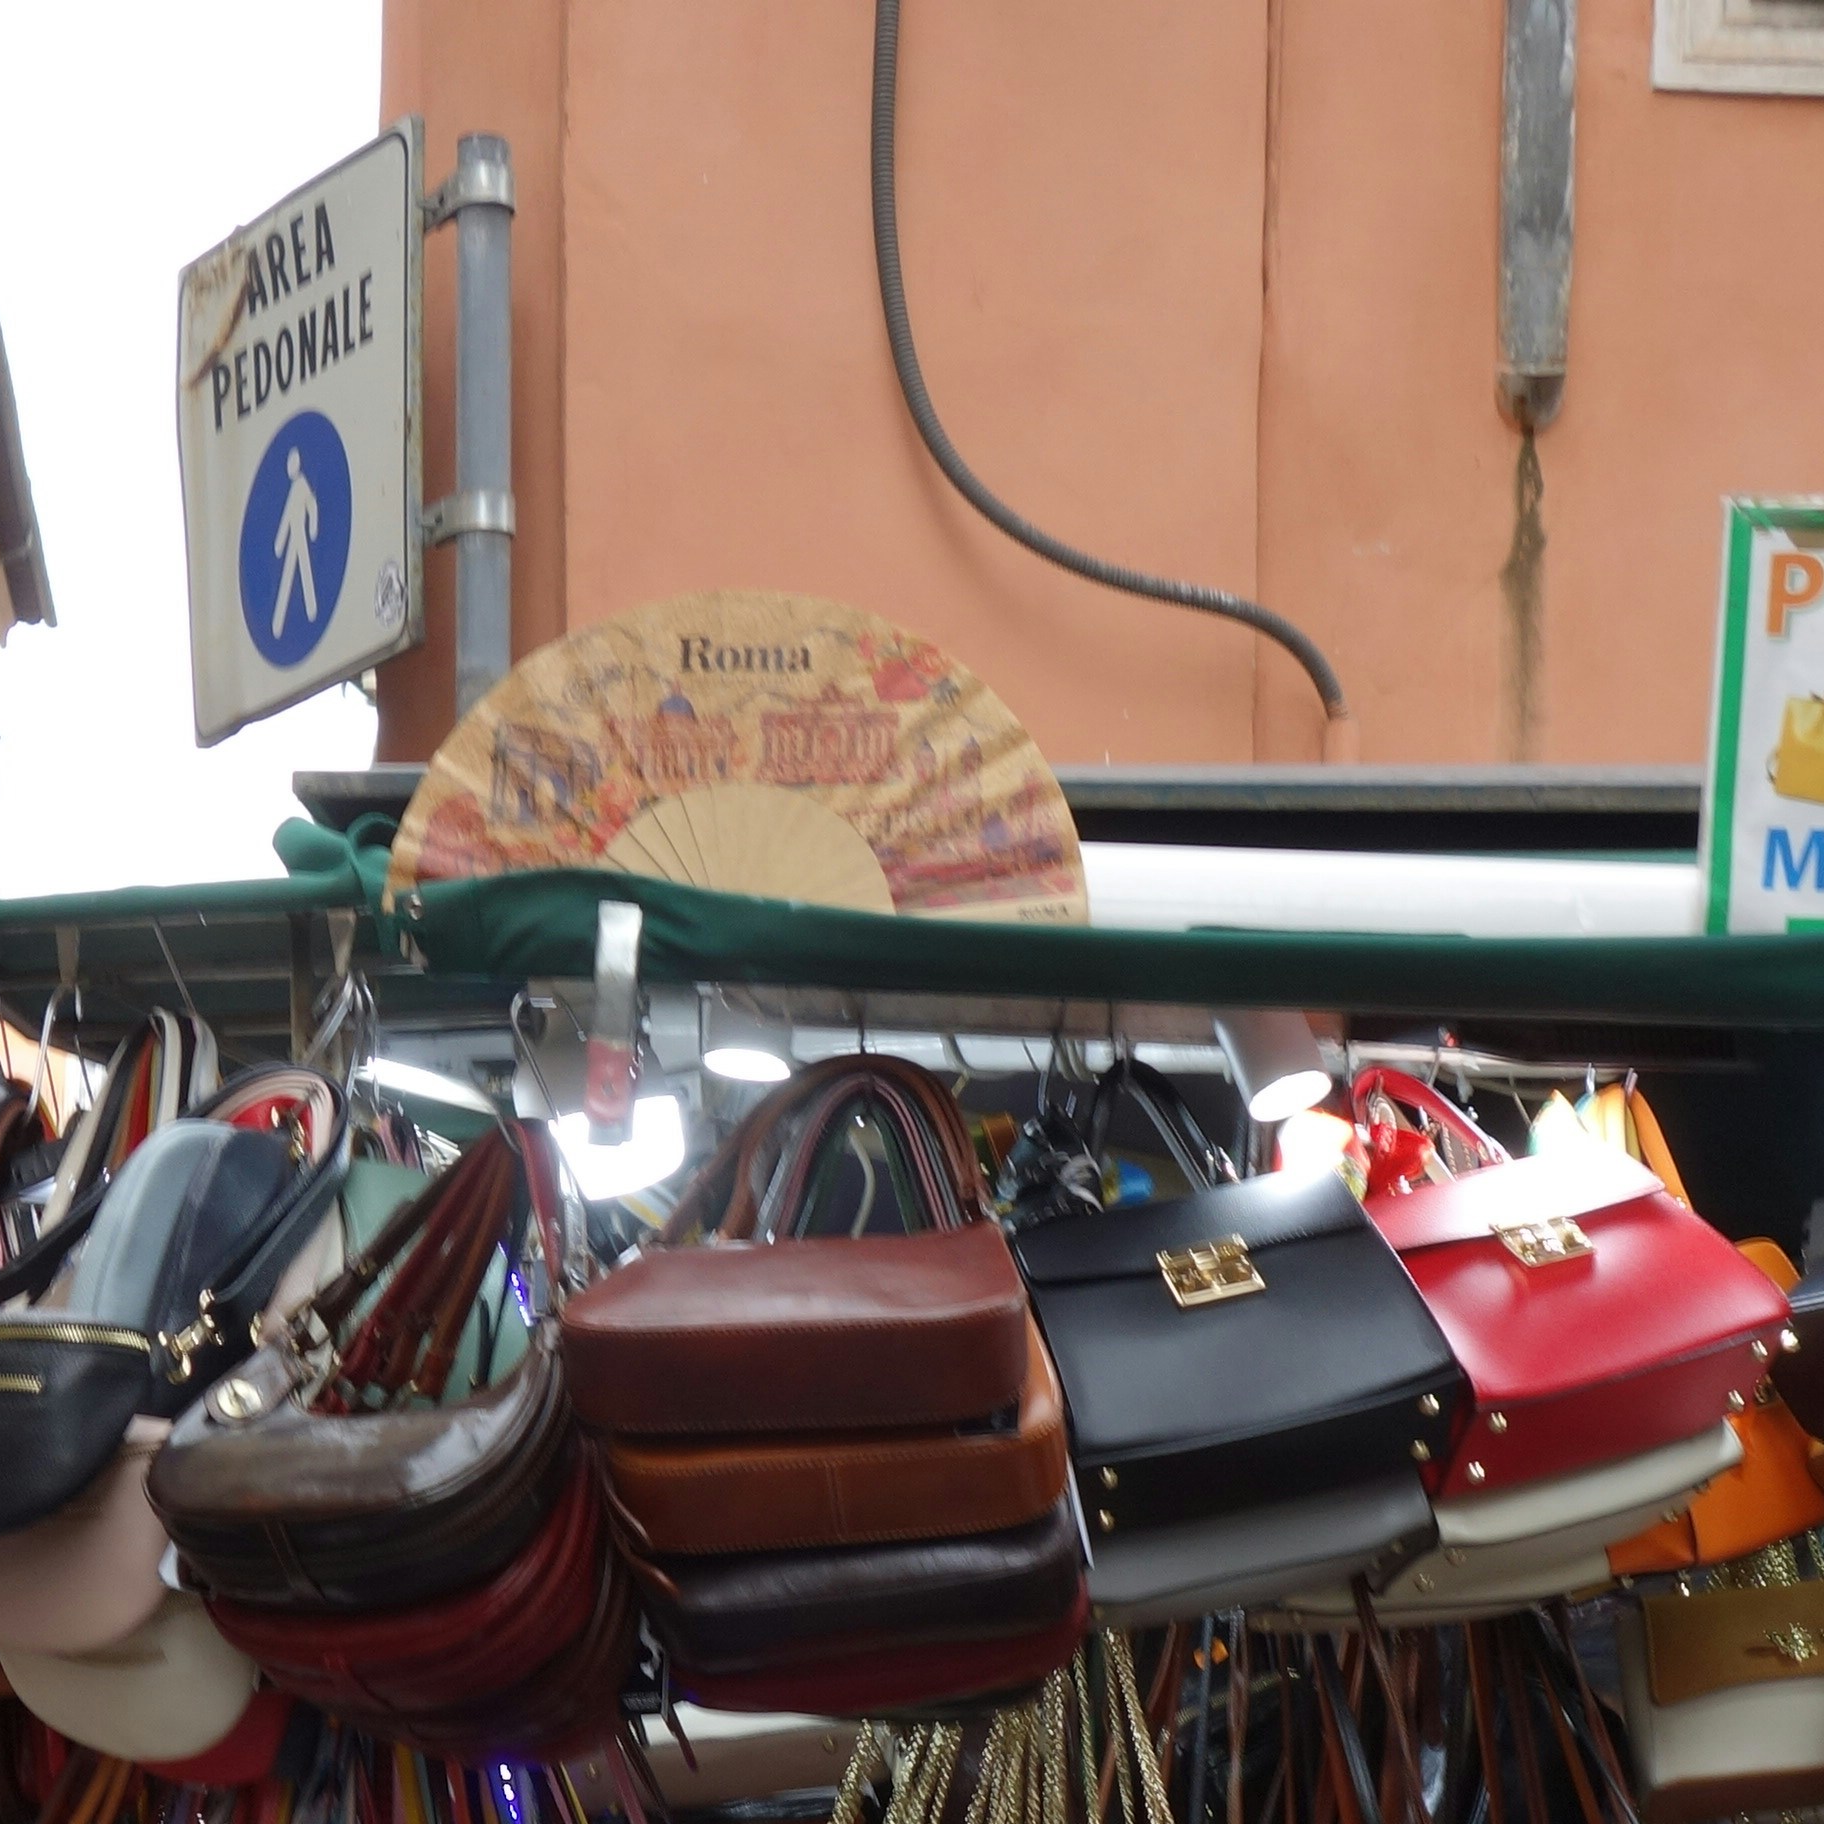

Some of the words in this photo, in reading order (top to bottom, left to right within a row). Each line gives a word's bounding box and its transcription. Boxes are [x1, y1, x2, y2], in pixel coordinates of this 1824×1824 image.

[246, 200, 337, 317] AREA
[210, 270, 374, 435] PEDONALE
[678, 635, 814, 677] Roma
